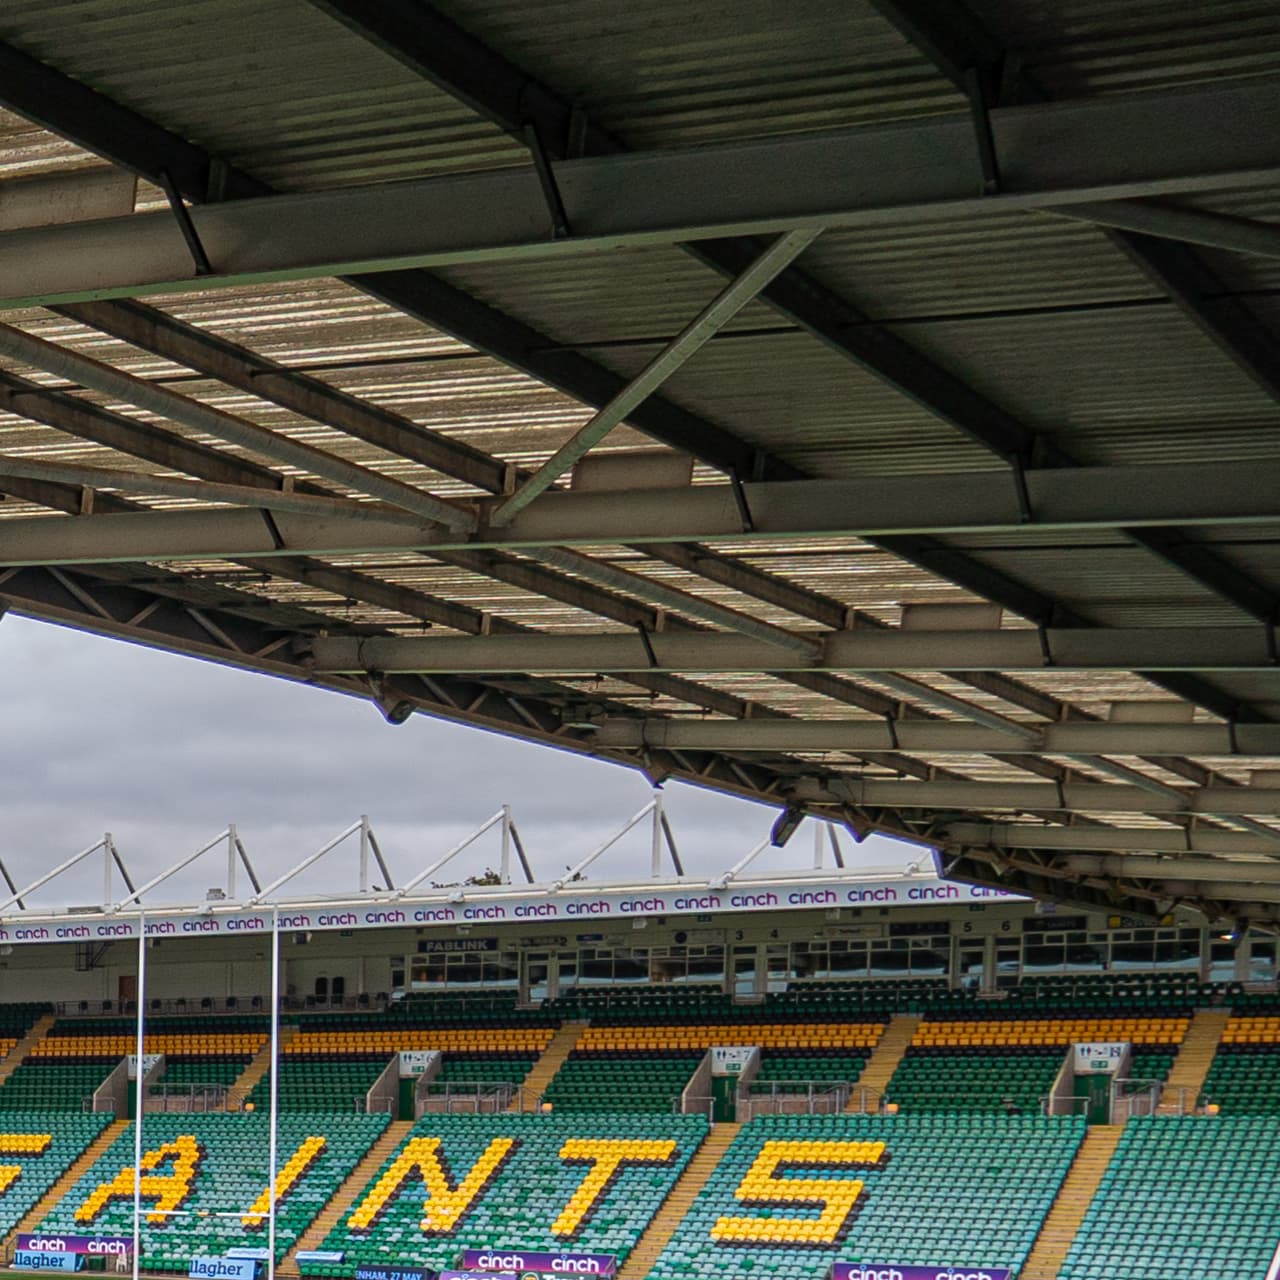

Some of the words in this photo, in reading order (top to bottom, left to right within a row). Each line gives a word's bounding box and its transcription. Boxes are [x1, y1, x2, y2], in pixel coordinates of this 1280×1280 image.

[16, 928, 48, 939] cinch
[56, 926, 90, 938] cinch
[98, 924, 132, 936] cinch
[184, 920, 220, 932] cinch
[227, 918, 264, 930] cinch
[318, 913, 357, 926] cinch
[366, 910, 405, 924] cinch
[414, 908, 454, 921] cinch
[464, 905, 504, 918] cinch
[514, 903, 556, 916] cinch
[566, 900, 610, 914] cinch
[620, 898, 664, 912] cinch
[674, 896, 720, 910] cinch
[731, 893, 778, 907] cinch
[789, 890, 836, 904] cinch
[848, 888, 896, 902] cinch
[908, 886, 958, 900] cinch
[963, 921, 972, 932] 5
[1001, 920, 1010, 931] 6
[736, 930, 744, 941] 3
[770, 929, 778, 938] 4
[426, 940, 488, 951] FABLINK
[28, 1237, 66, 1252] cinch
[87, 1238, 126, 1253] cinch
[16, 1252, 65, 1269] llagher
[478, 1252, 524, 1270] cinch
[551, 1255, 599, 1273] cinch
[190, 1259, 243, 1277] llagher
